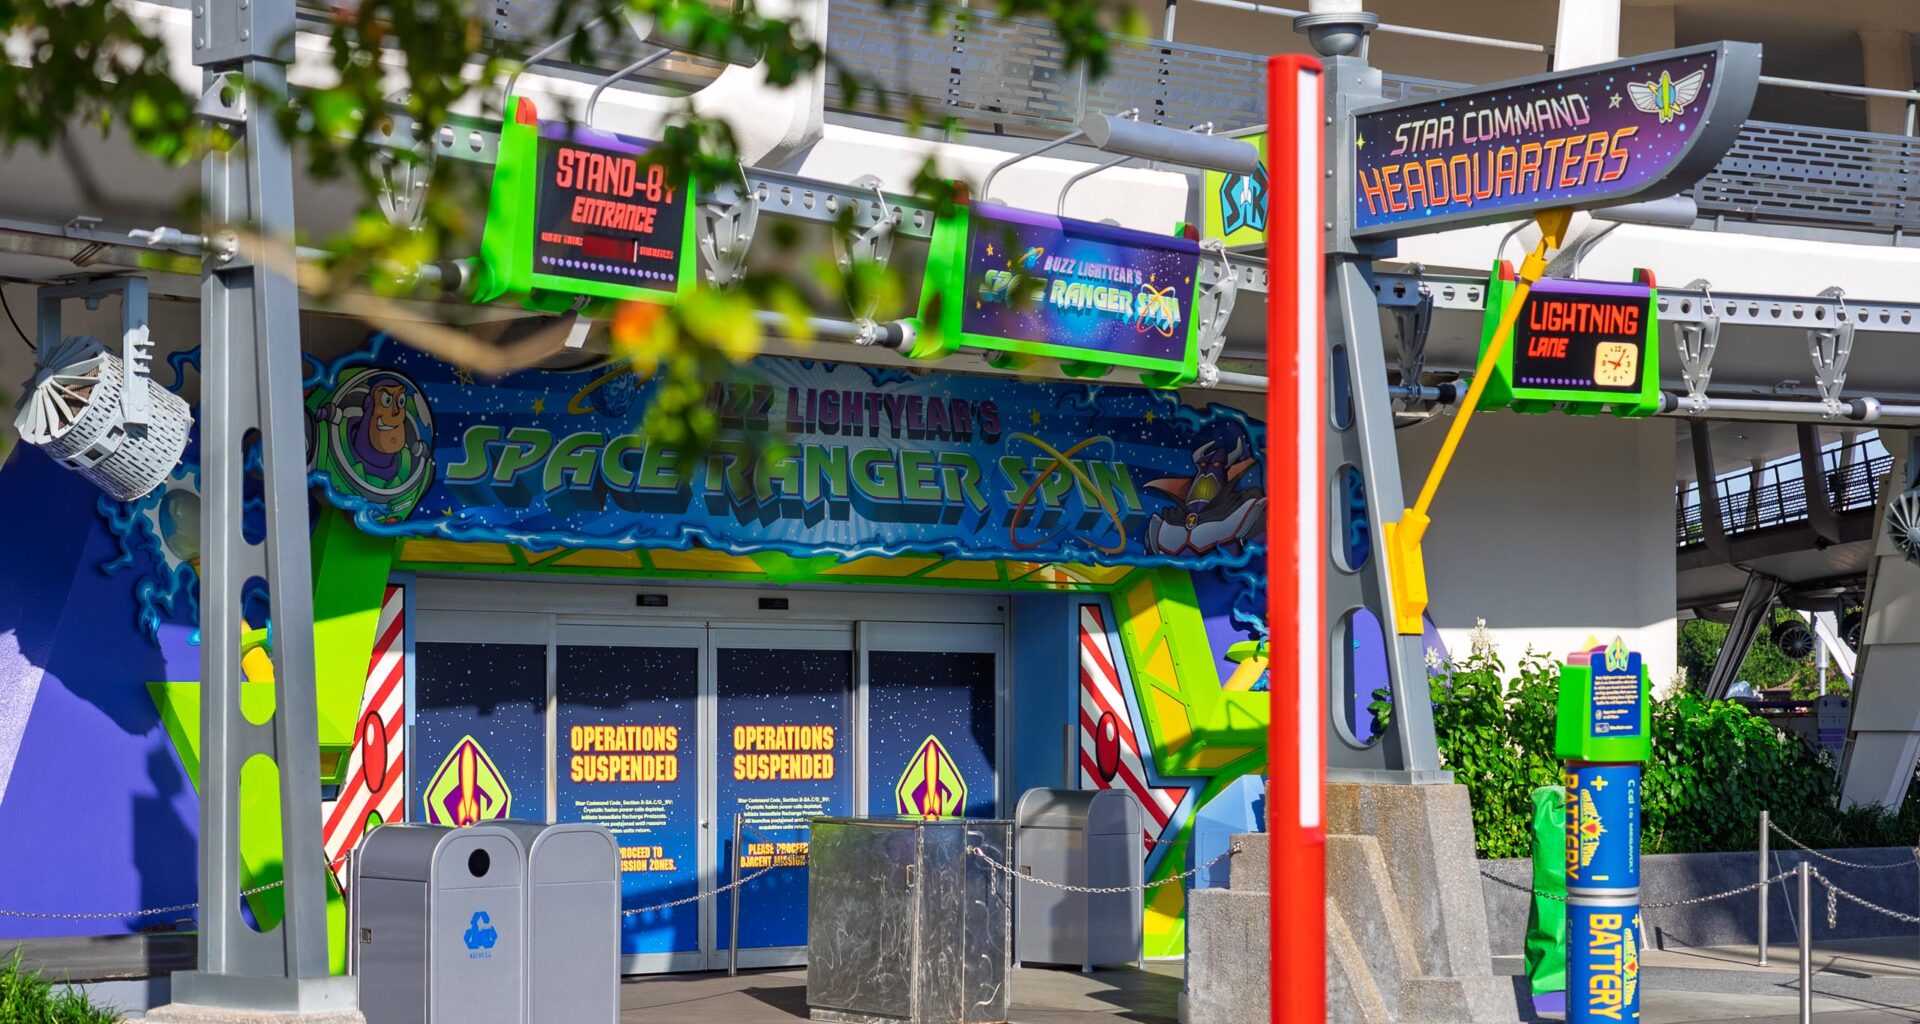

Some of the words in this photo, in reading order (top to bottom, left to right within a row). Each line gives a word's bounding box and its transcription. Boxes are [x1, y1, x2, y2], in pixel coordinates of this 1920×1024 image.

[1390, 115, 1455, 156] STAR
[1463, 93, 1591, 144] COMMAND
[1359, 126, 1640, 216] HEADQUARTERS
[571, 196, 657, 234] ENTRANCE
[1043, 255, 1076, 276] BUZZ
[1078, 261, 1143, 286] LIGHTYEAR'S
[1050, 280, 1134, 316] RANGER
[1137, 292, 1182, 323] SPIN
[1530, 300, 1639, 336] LIGHTNING
[1528, 336, 1568, 360] LANE
[786, 387, 1001, 437] LIGHTYEAR'S
[445, 424, 681, 494] SPACE
[704, 439, 990, 512] RANGER
[998, 453, 1147, 515] SPIN
[570, 725, 679, 752] OPERATIONS
[733, 725, 835, 752] OPERATIONS
[570, 754, 679, 783] SUSPENDED
[733, 753, 835, 782] SUSPENDED
[1566, 773, 1580, 881] BATTERY
[652, 846, 663, 858] TO
[740, 855, 772, 868] DJACENT
[748, 842, 775, 855] PLEASE
[620, 859, 647, 872] ISSION
[649, 858, 677, 871] ZONES.
[1588, 913, 1623, 1021] BATTERY
